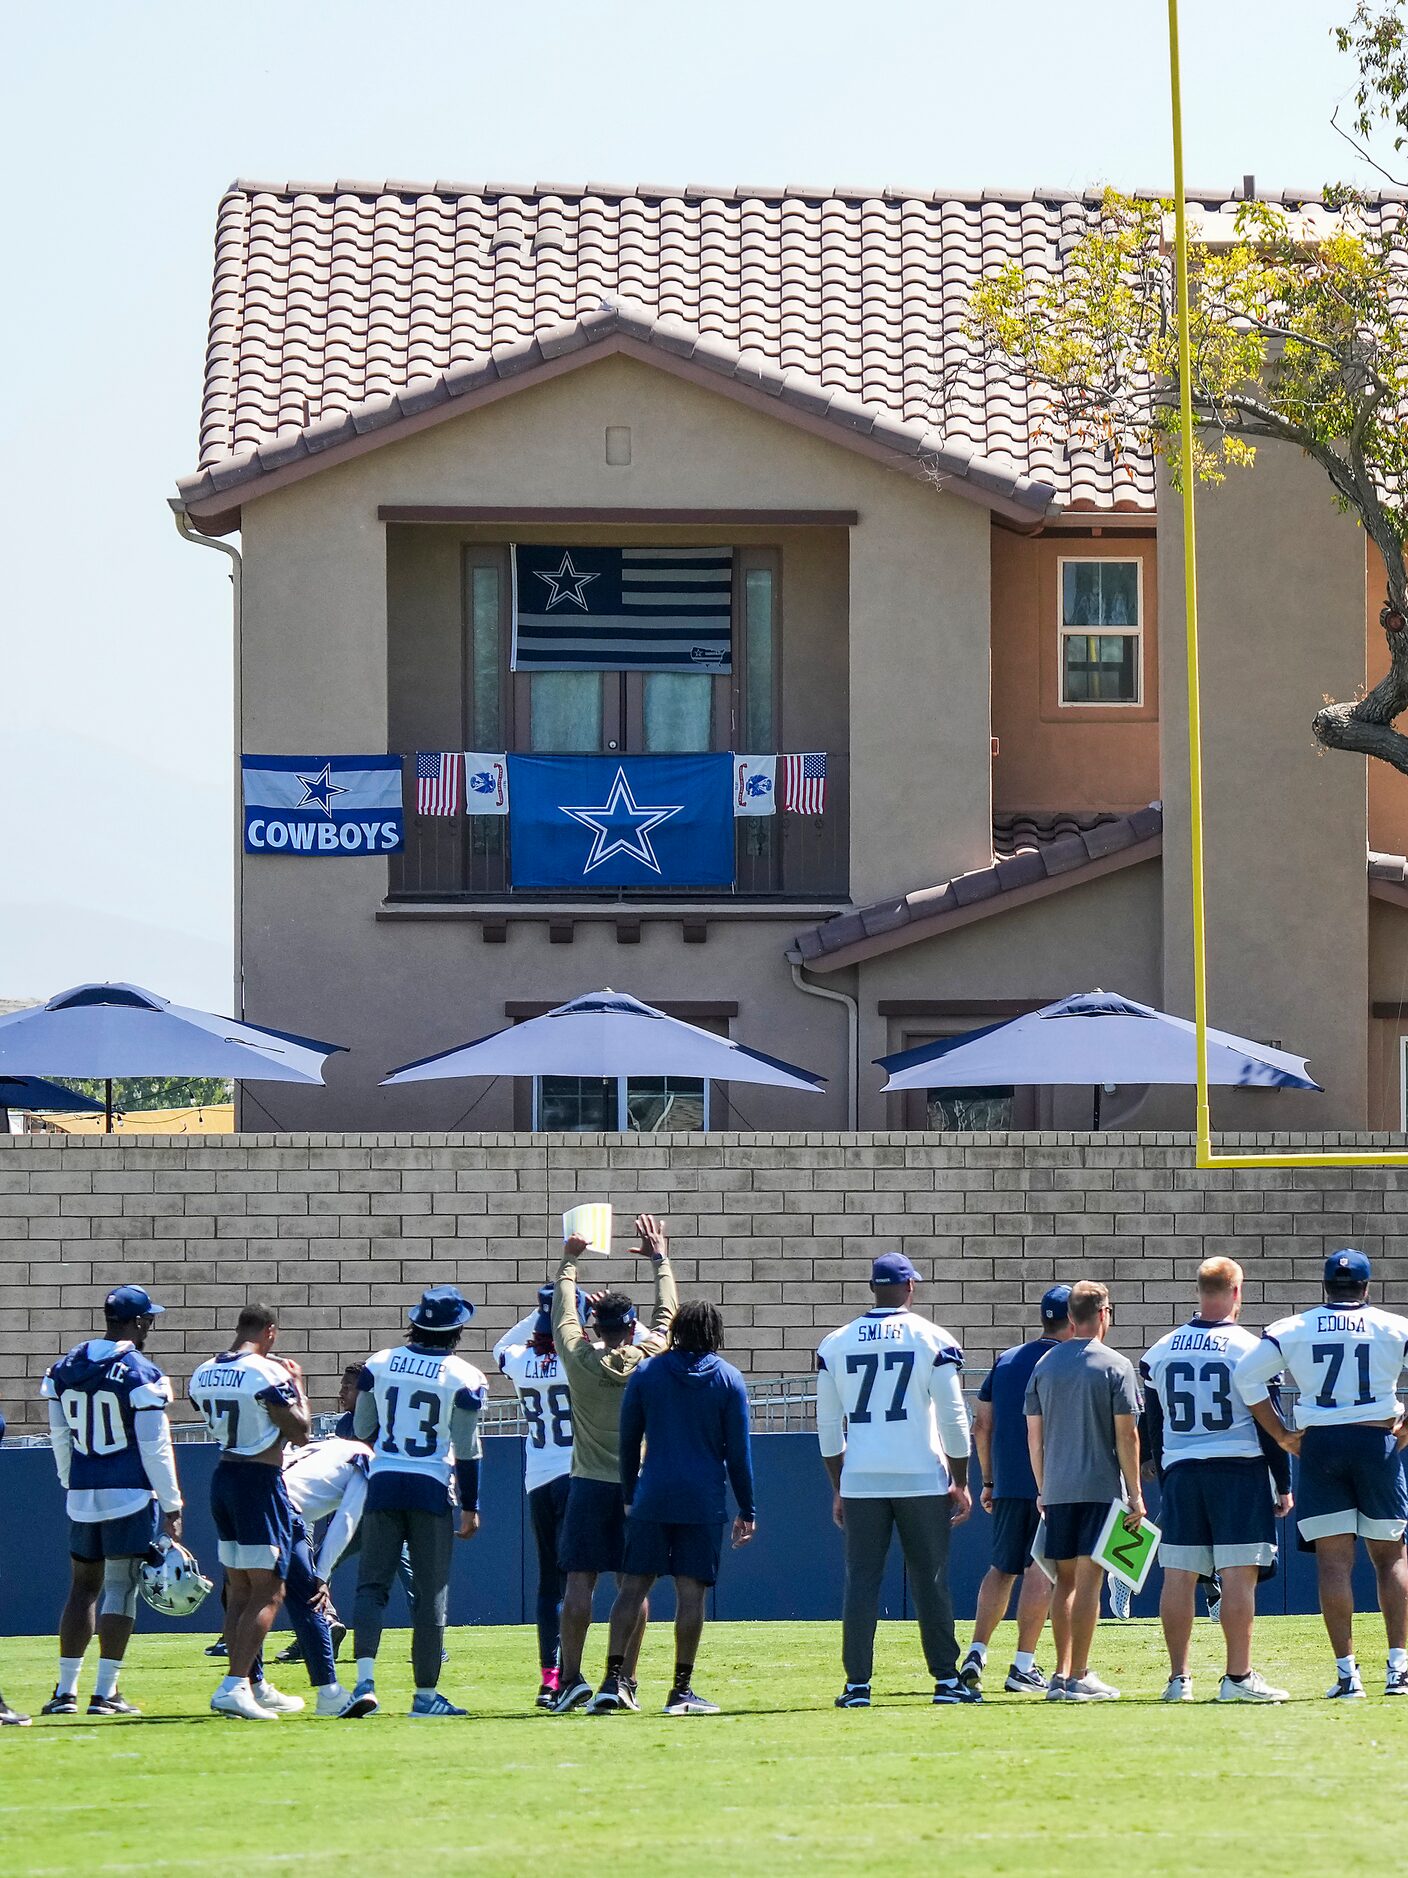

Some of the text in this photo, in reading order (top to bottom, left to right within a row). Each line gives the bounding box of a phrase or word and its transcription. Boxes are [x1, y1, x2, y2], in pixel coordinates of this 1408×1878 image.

[248, 820, 400, 850] COWBOYS
[858, 1323, 903, 1342] SMITH
[1170, 1333, 1230, 1353] BIADASZ
[1317, 1314, 1366, 1333] EDOGA
[389, 1355, 447, 1379] GALLUP
[525, 1357, 557, 1379] LAMB
[846, 1351, 915, 1423] 77
[1311, 1343, 1377, 1408] 71
[520, 1384, 573, 1449] 88
[1165, 1361, 1234, 1432] 63
[60, 1388, 128, 1456] 90
[381, 1386, 441, 1457] 13
